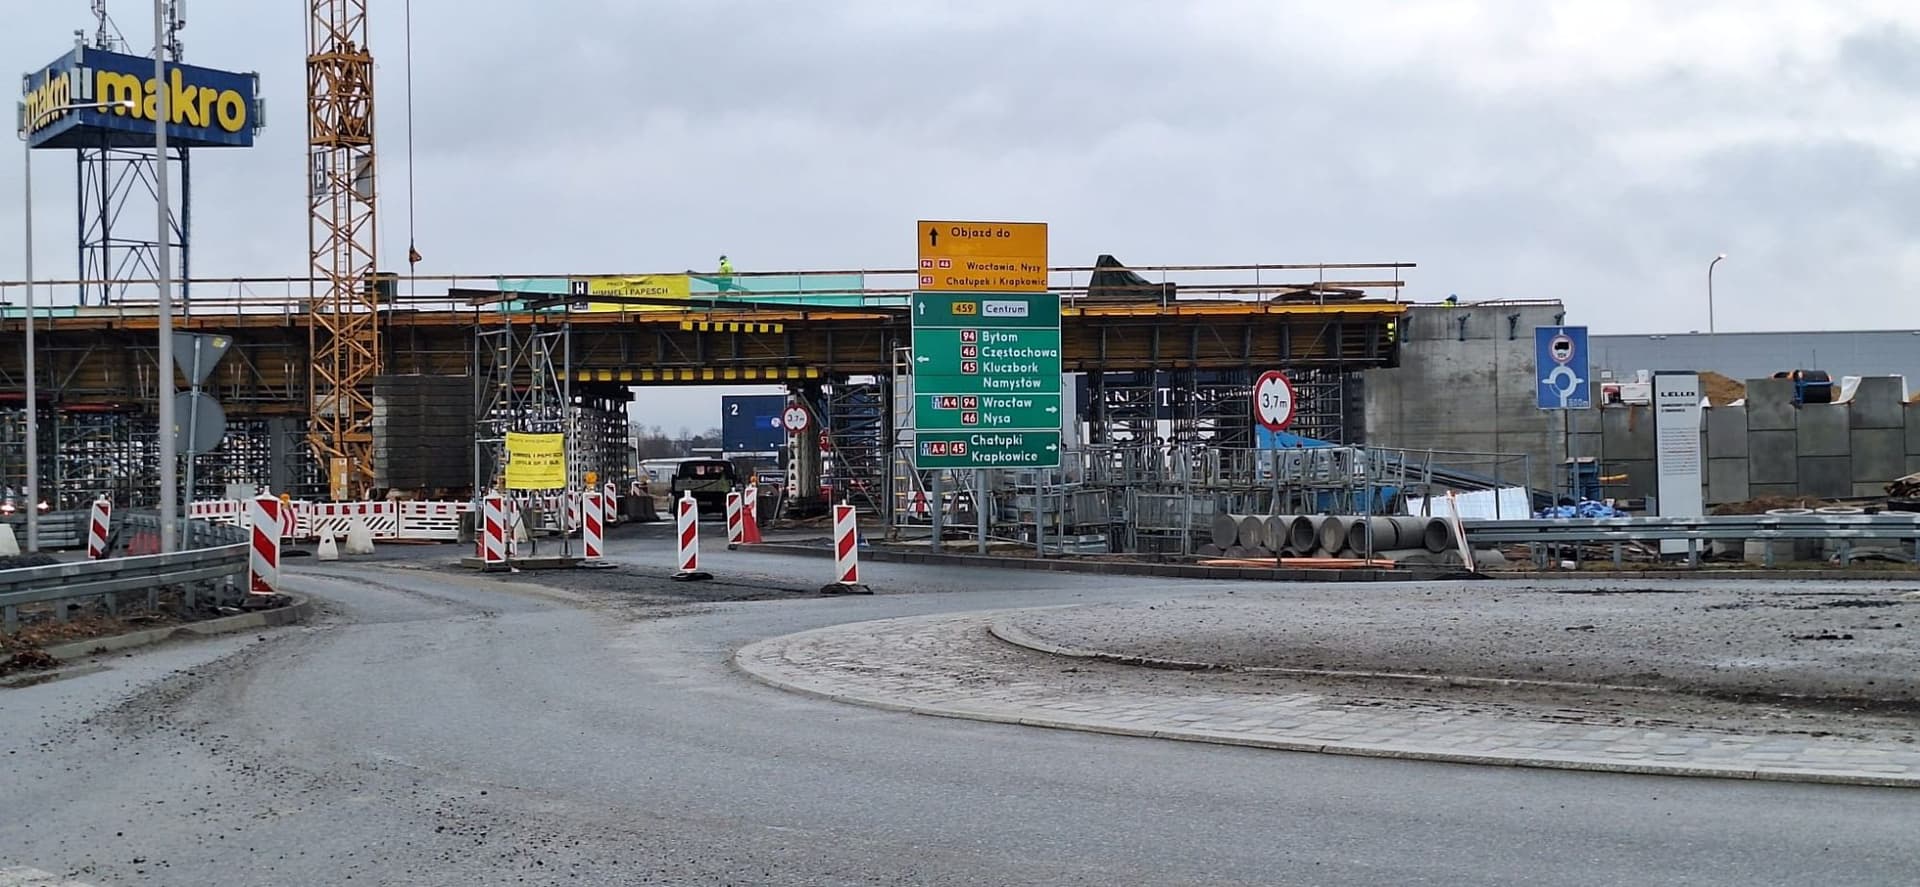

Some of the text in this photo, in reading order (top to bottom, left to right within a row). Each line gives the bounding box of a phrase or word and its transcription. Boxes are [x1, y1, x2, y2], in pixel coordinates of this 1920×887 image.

[25, 67, 70, 134] makro
[96, 68, 247, 133] makro
[951, 227, 1011, 240] Objazd do
[1020, 263, 1041, 273] Nysy
[946, 277, 991, 287] Chałupek
[630, 287, 669, 296] PAPESCH
[955, 303, 1026, 314] 459 Centrum
[962, 331, 1018, 345] 94 Bytom
[962, 346, 1058, 360] 46 Częstochowa
[962, 362, 1039, 374] 45 Kluczbork
[983, 377, 1042, 391] Namysłów
[943, 396, 1033, 408] A4 94 Wrocław
[1262, 392, 1288, 410] 3,7m
[731, 403, 739, 416] 2
[963, 412, 1011, 426] 46 Nysa
[970, 433, 1023, 449] Chałupki
[932, 443, 965, 454] A4 45
[971, 450, 1038, 464] Krapkowice
